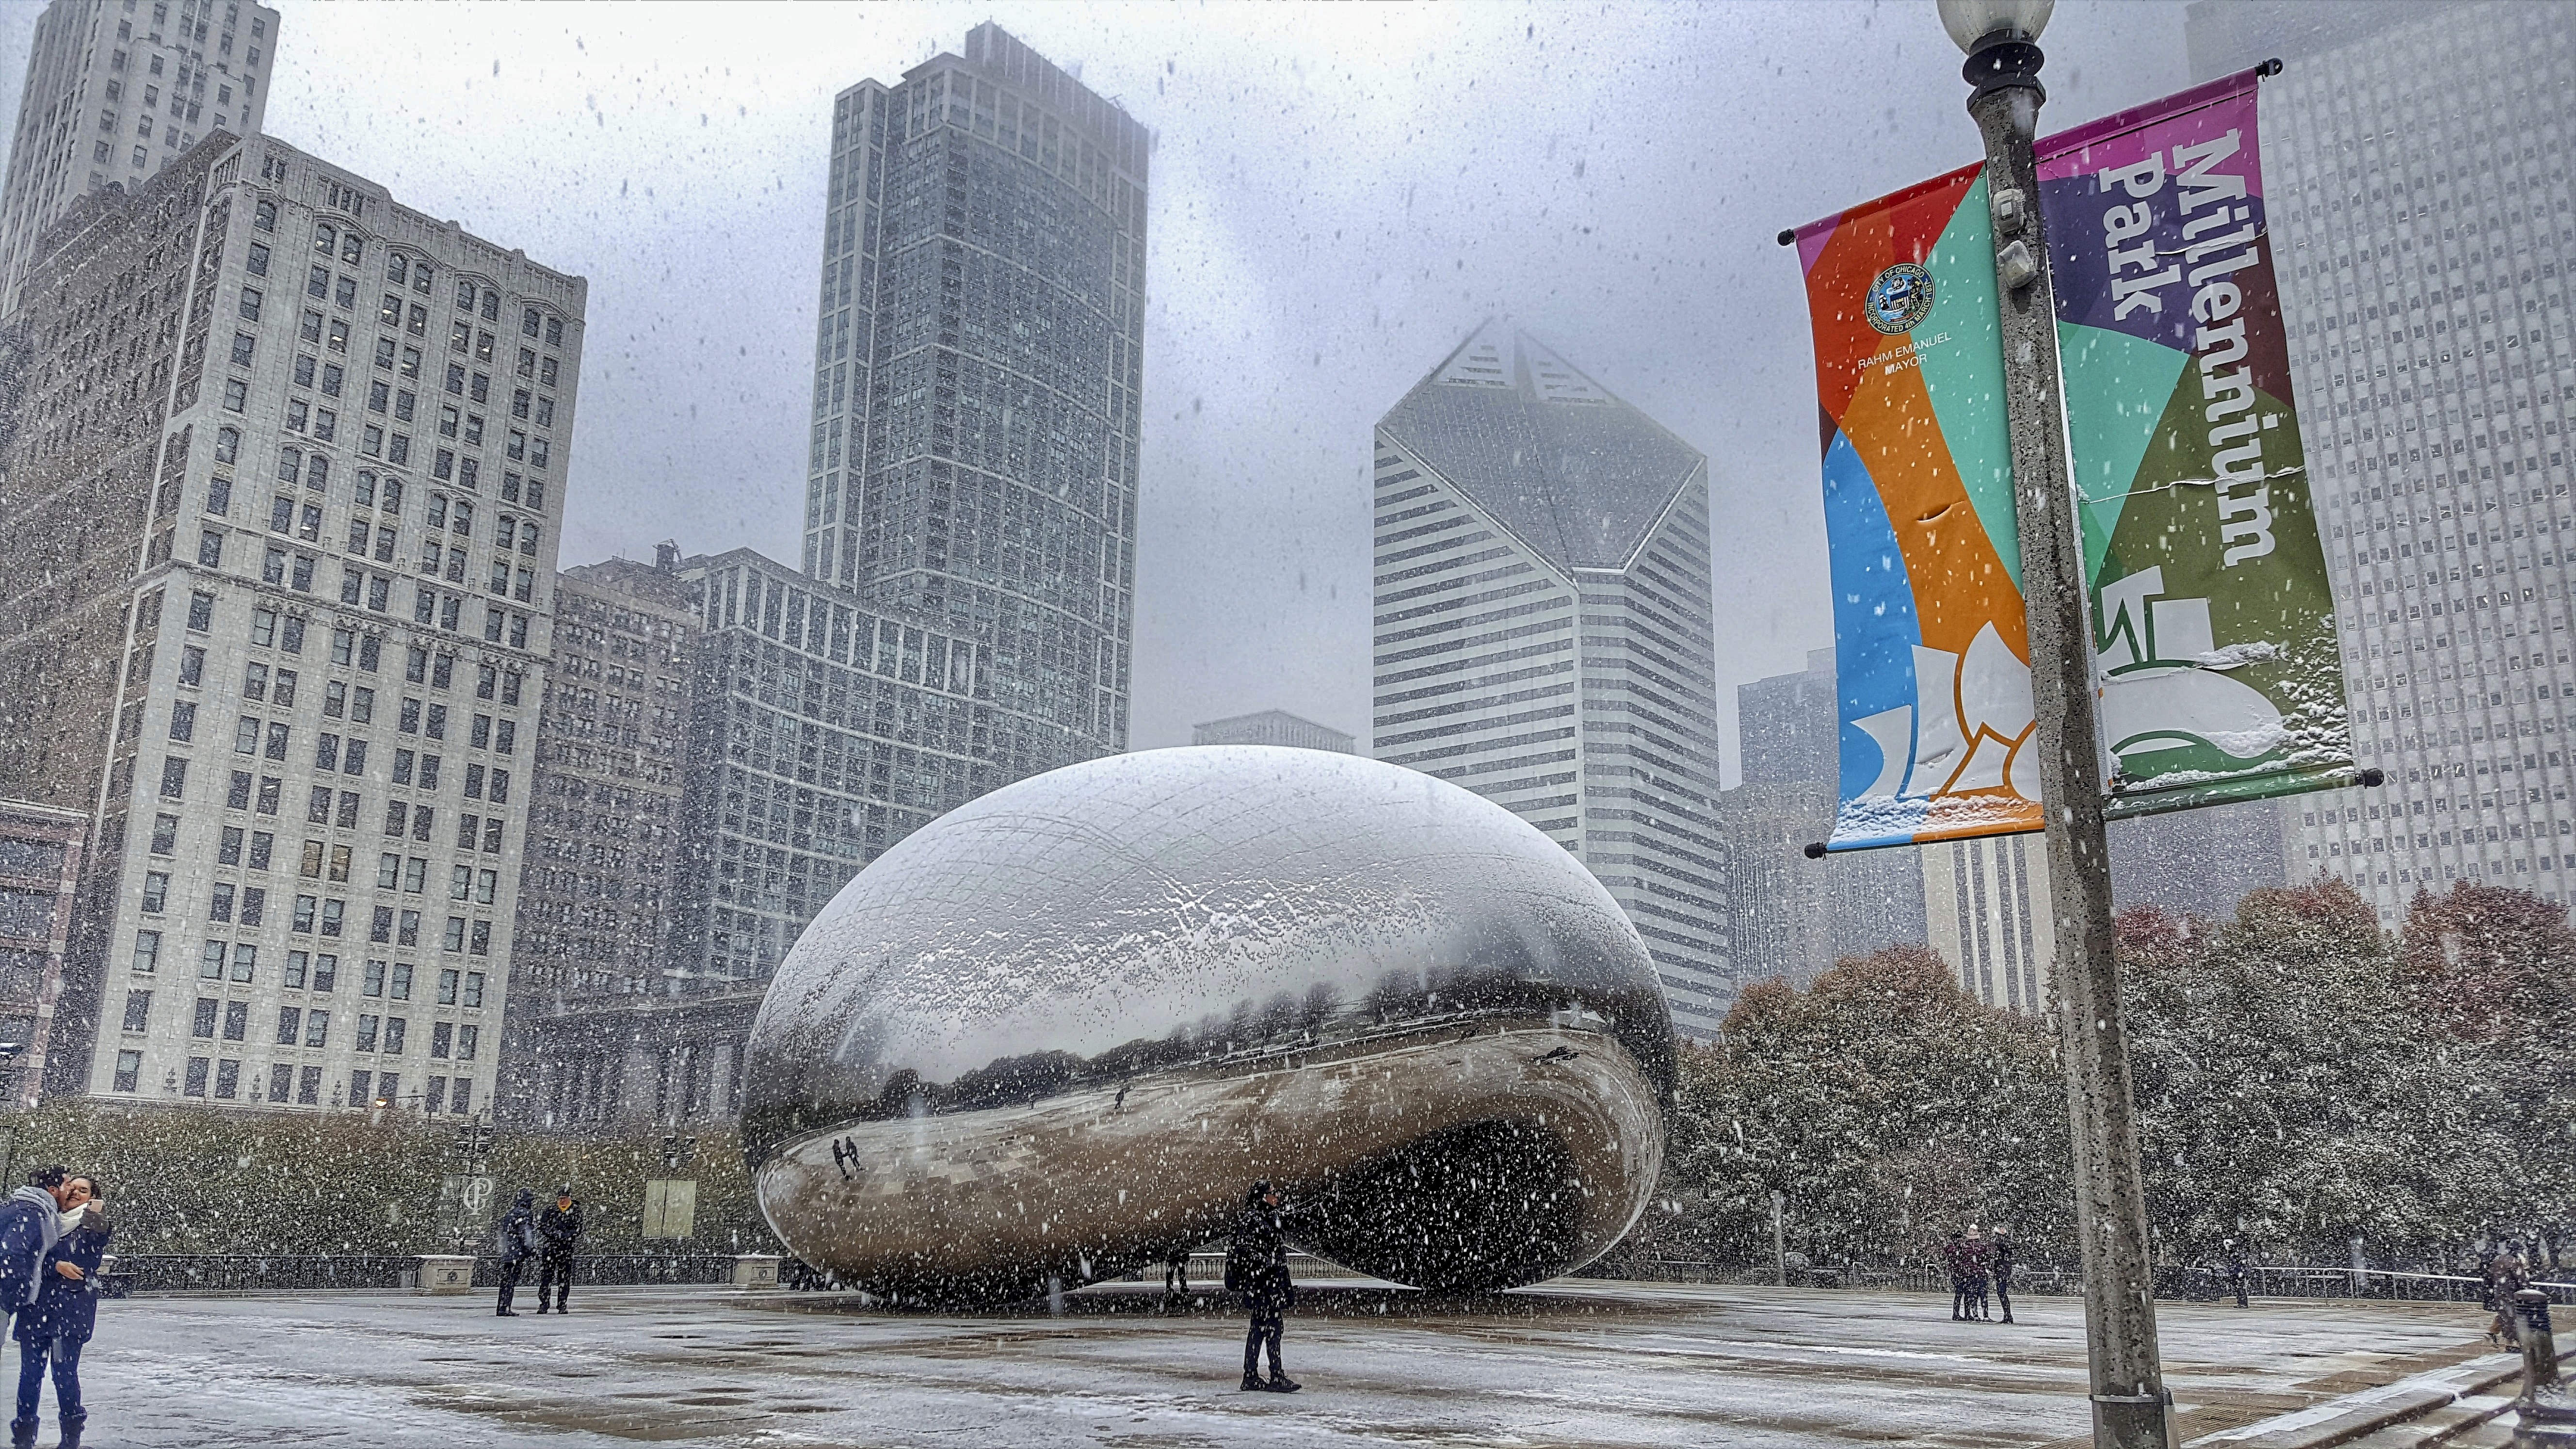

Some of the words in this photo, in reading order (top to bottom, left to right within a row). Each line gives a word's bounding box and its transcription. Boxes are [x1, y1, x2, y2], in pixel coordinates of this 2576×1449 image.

[2099, 151, 2182, 321] Park
[1872, 277, 1885, 292] CITY
[1885, 269, 1895, 279] OF
[1896, 266, 1925, 278] CHICAGO
[1868, 302, 1903, 333] INCORPORATED
[1905, 320, 1915, 329] 4th
[1914, 297, 1931, 322] MARCH
[1858, 350, 1893, 370] RAHM
[1896, 332, 1952, 357] EMANUEL
[1884, 354, 1927, 376] MAYOR
[2173, 128, 2277, 566] Millennium
